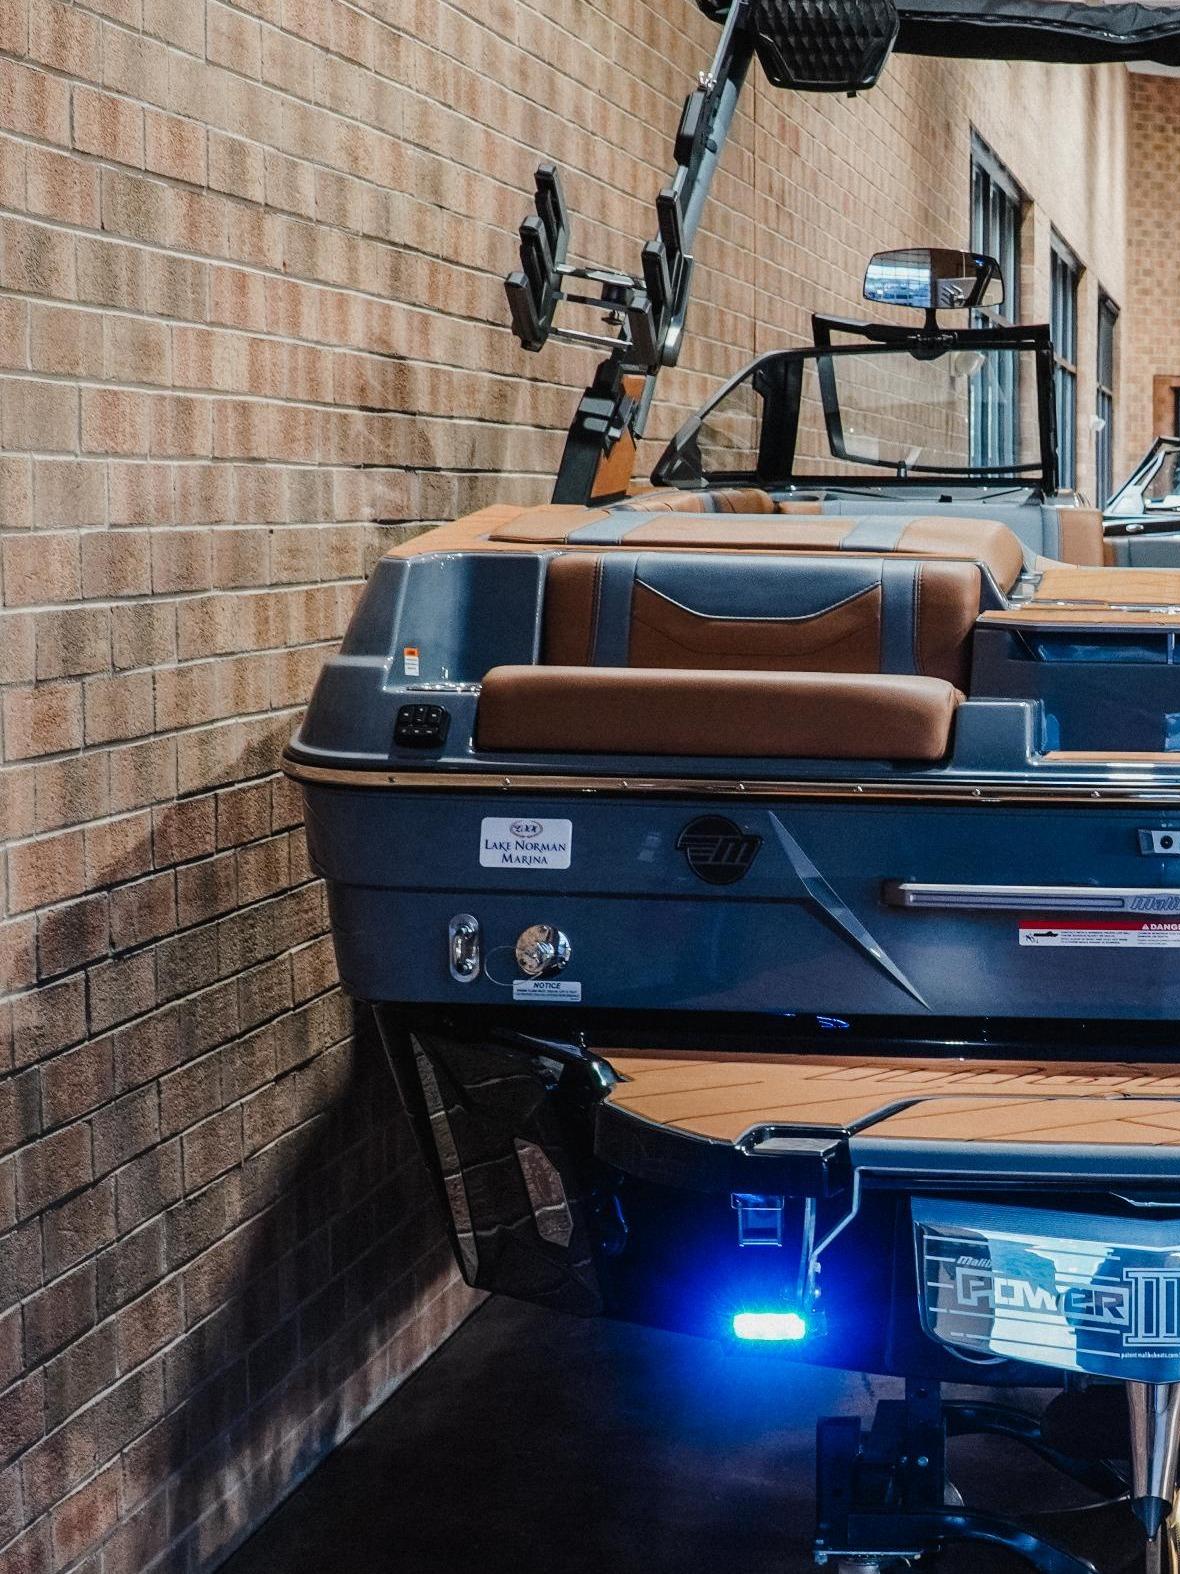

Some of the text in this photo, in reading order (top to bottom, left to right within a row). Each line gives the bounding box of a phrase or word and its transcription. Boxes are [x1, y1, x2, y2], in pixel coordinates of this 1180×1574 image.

[485, 839, 566, 853] LAKE NORMAN
[501, 853, 548, 865] MARINA
[533, 982, 561, 990] NOTICE
[957, 1256, 994, 1270] Malib
[958, 1268, 1127, 1322] POWER
